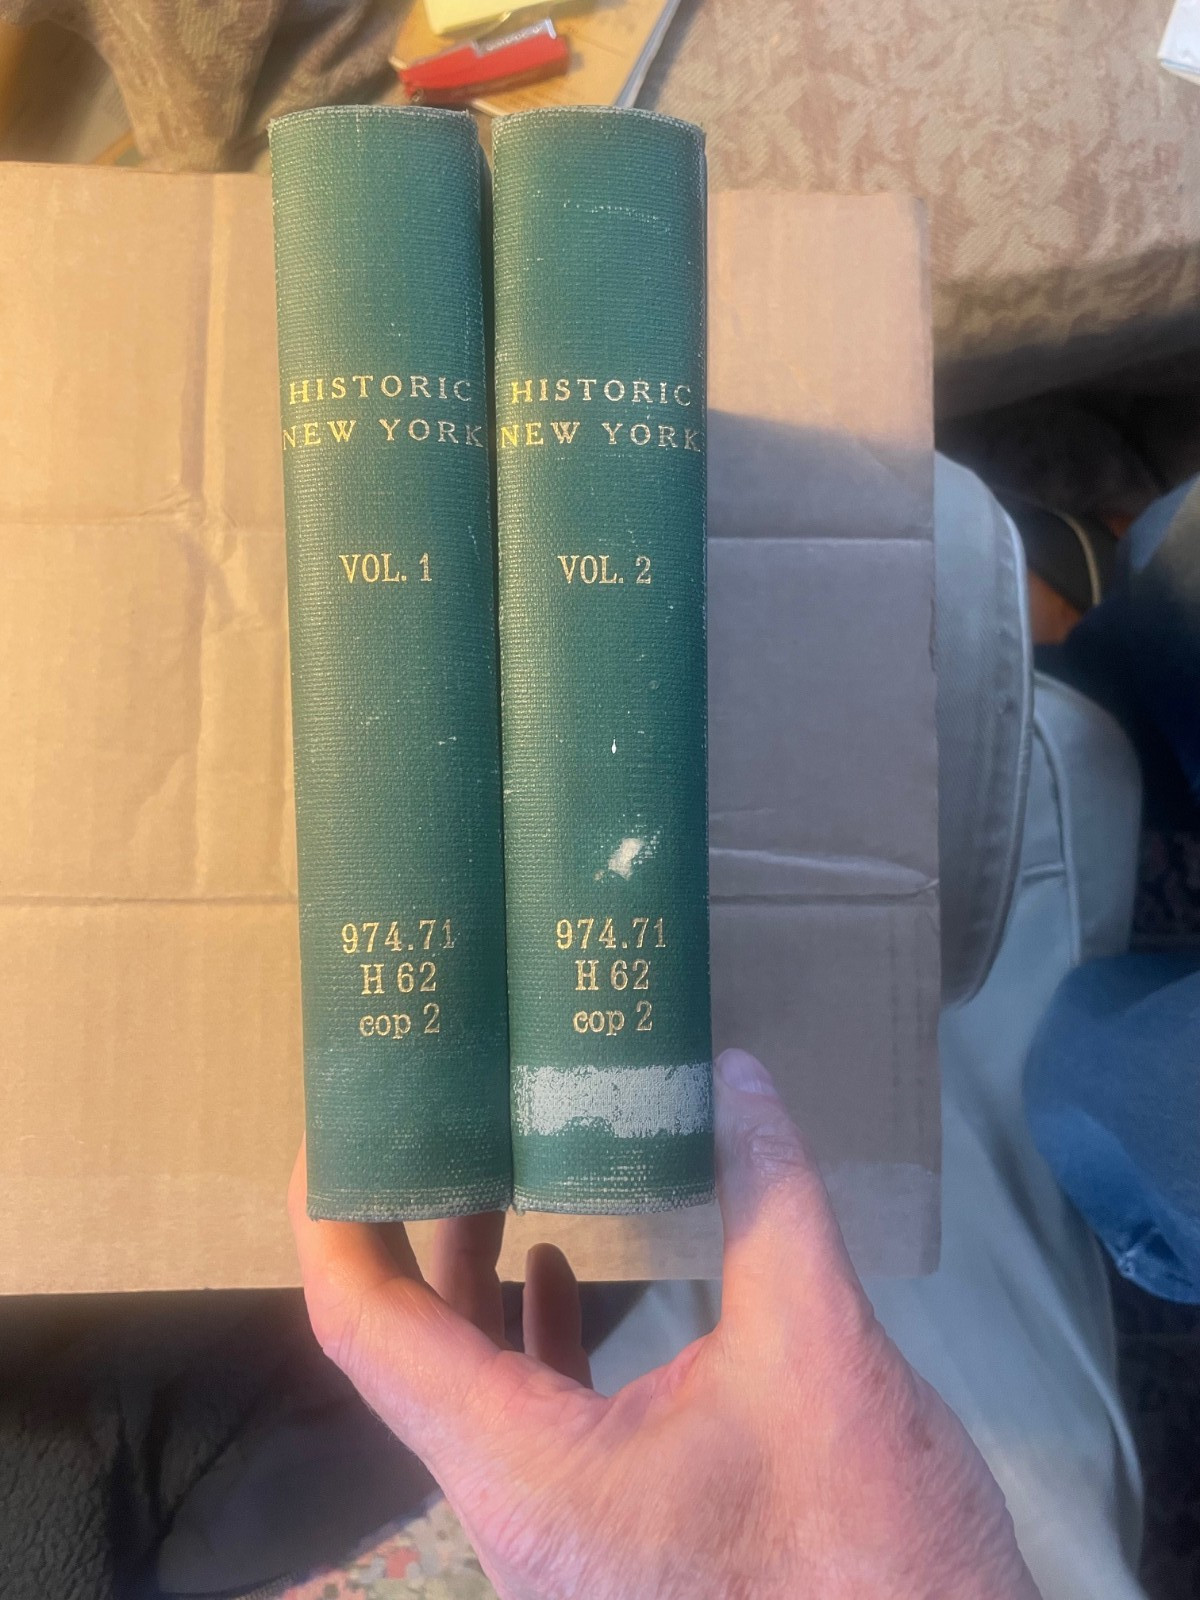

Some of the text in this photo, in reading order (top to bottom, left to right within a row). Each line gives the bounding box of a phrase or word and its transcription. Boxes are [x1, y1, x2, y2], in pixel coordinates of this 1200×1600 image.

[289, 375, 472, 405] HISTORIC
[510, 378, 693, 406] HISTORIC
[283, 419, 484, 451] NEW YORK
[501, 421, 701, 452] NEW YORK
[339, 552, 432, 584] VOL. 1
[558, 554, 652, 585] VOL. 2
[341, 919, 455, 953] 974.71
[556, 917, 666, 950] 974.71
[360, 962, 437, 995] H 62
[575, 959, 649, 991] H 62
[359, 1003, 441, 1039] cop 2
[573, 1001, 653, 1036] cop 2
